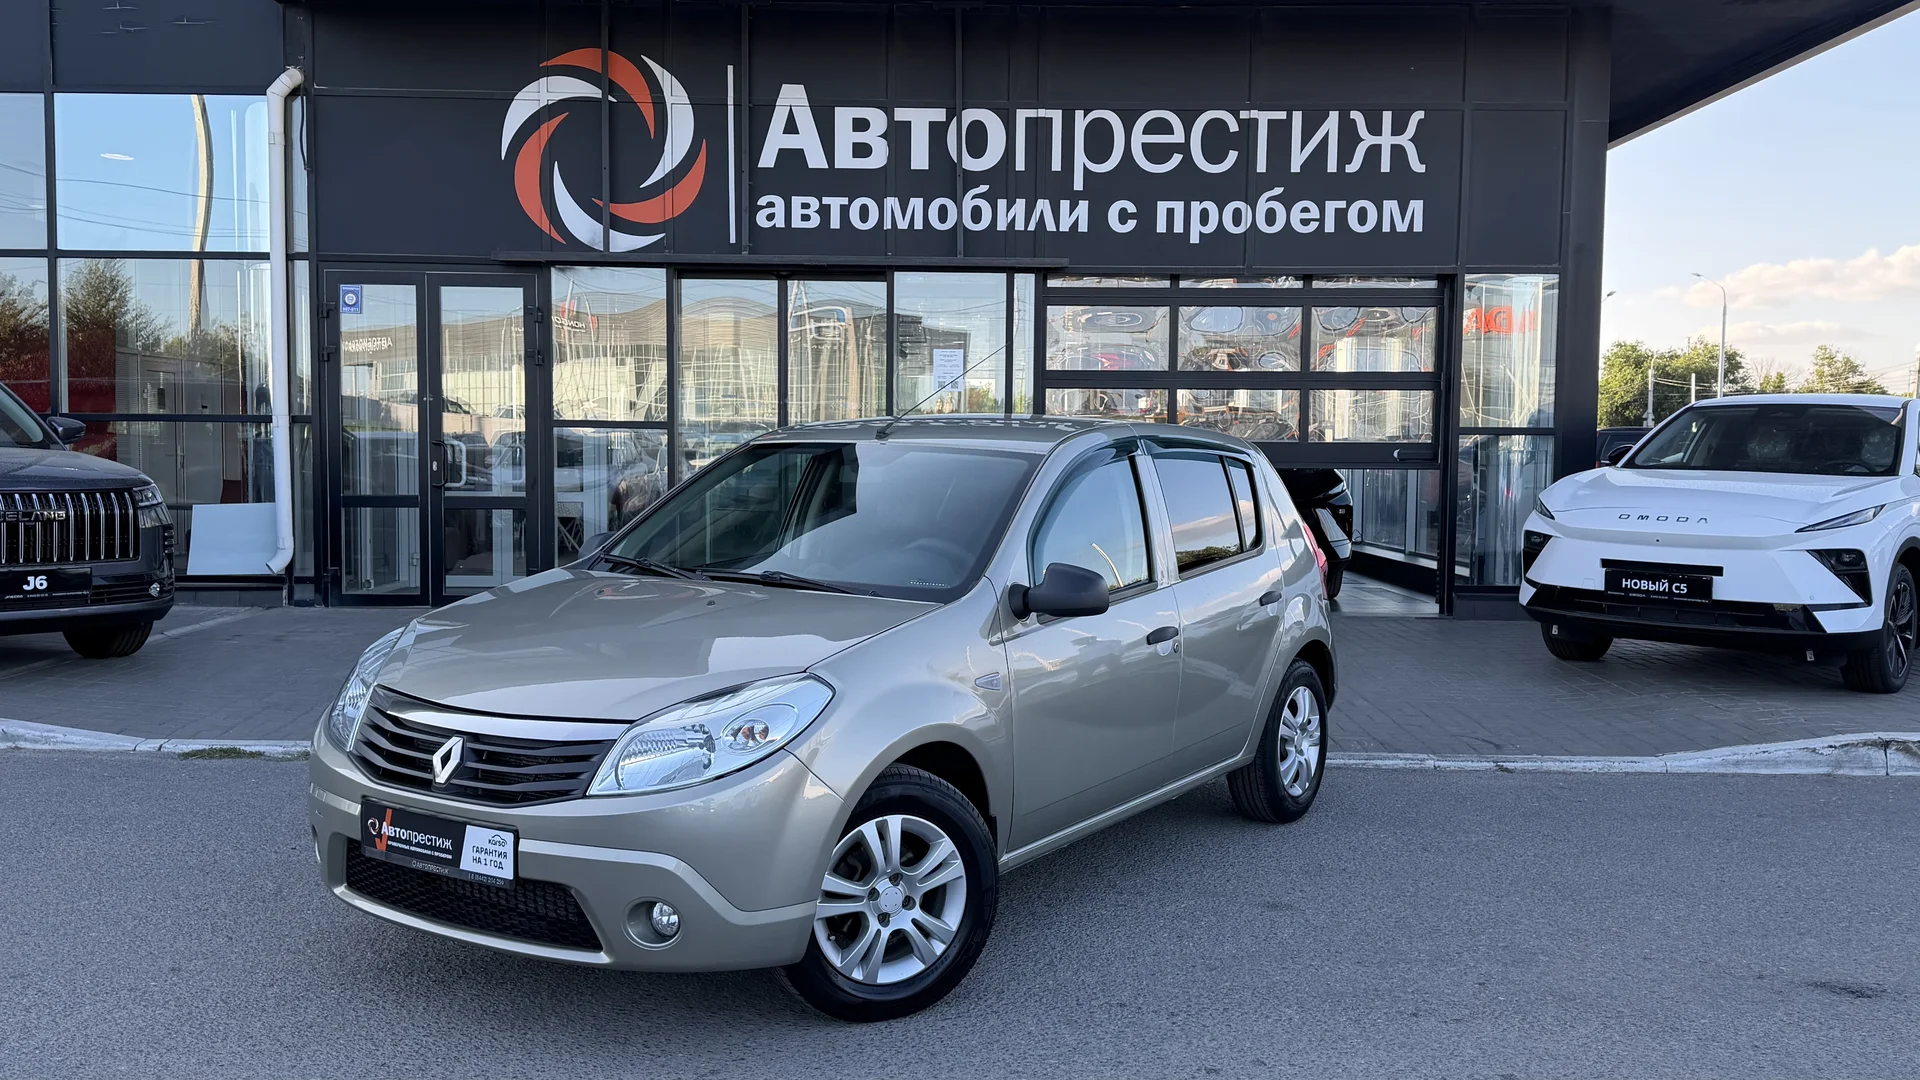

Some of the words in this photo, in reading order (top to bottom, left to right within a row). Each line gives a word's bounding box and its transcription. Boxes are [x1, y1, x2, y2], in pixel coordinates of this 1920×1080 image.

[757, 83, 1427, 191] Автопрестиж
[755, 185, 1090, 233] автомобили
[1107, 199, 1138, 233] с
[1156, 187, 1424, 245] пробегом
[1617, 513, 1709, 524] OMODA
[22, 575, 48, 591] J6
[1621, 577, 1669, 593] НОВЫЙ
[380, 821, 453, 851] Автопрестиж
[472, 845, 508, 860] ГАРАНТИЯ
[472, 855, 483, 866] НА
[483, 858, 488, 867] 1
[489, 859, 504, 870] ГОД
